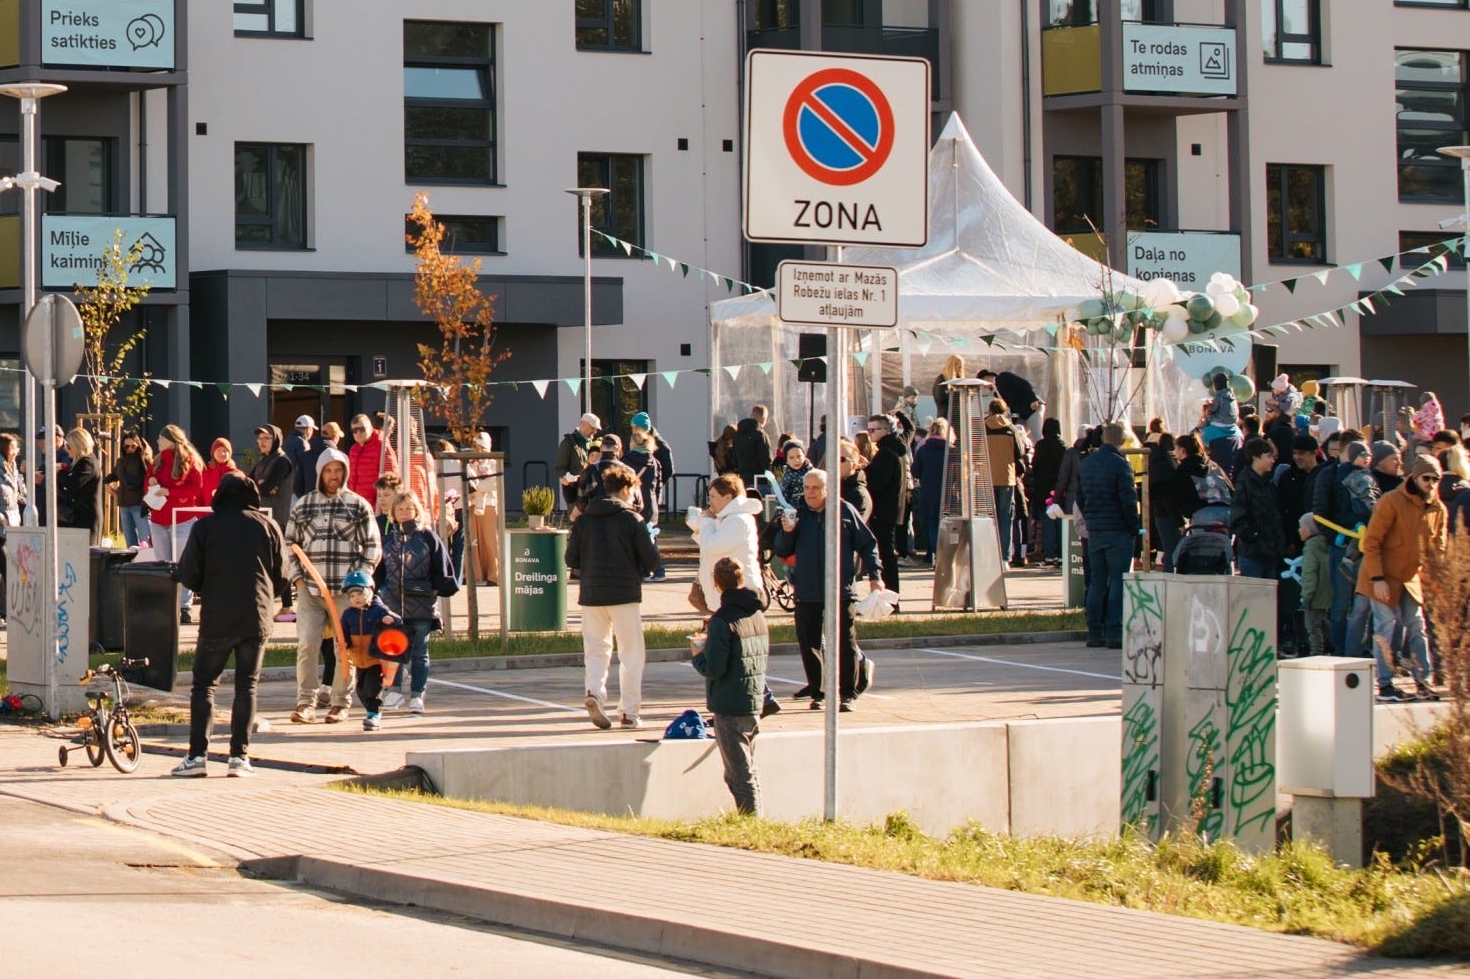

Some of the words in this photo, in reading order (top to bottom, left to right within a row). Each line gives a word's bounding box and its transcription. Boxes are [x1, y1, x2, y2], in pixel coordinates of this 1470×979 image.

[50, 10, 99, 27] Prieks
[51, 34, 117, 50] satikties
[1130, 39, 1146, 54] Te
[1150, 41, 1187, 56] rodas
[1130, 62, 1184, 79] atmiņas
[793, 199, 883, 232] ZONA
[50, 230, 90, 249] Mīļie
[1134, 245, 1165, 264] Daļa
[1169, 249, 1186, 262] no
[793, 268, 834, 284] Izņemot
[838, 273, 850, 283] ar
[854, 271, 887, 285] Mazās
[793, 285, 831, 299] Robežu
[834, 287, 859, 301] ielas
[861, 288, 877, 302] Nr.
[880, 289, 886, 302] 1
[819, 304, 863, 319] atļaujām
[377, 363, 382, 373] 1
[514, 571, 558, 583] Dreilinga
[514, 585, 544, 596] mājas
